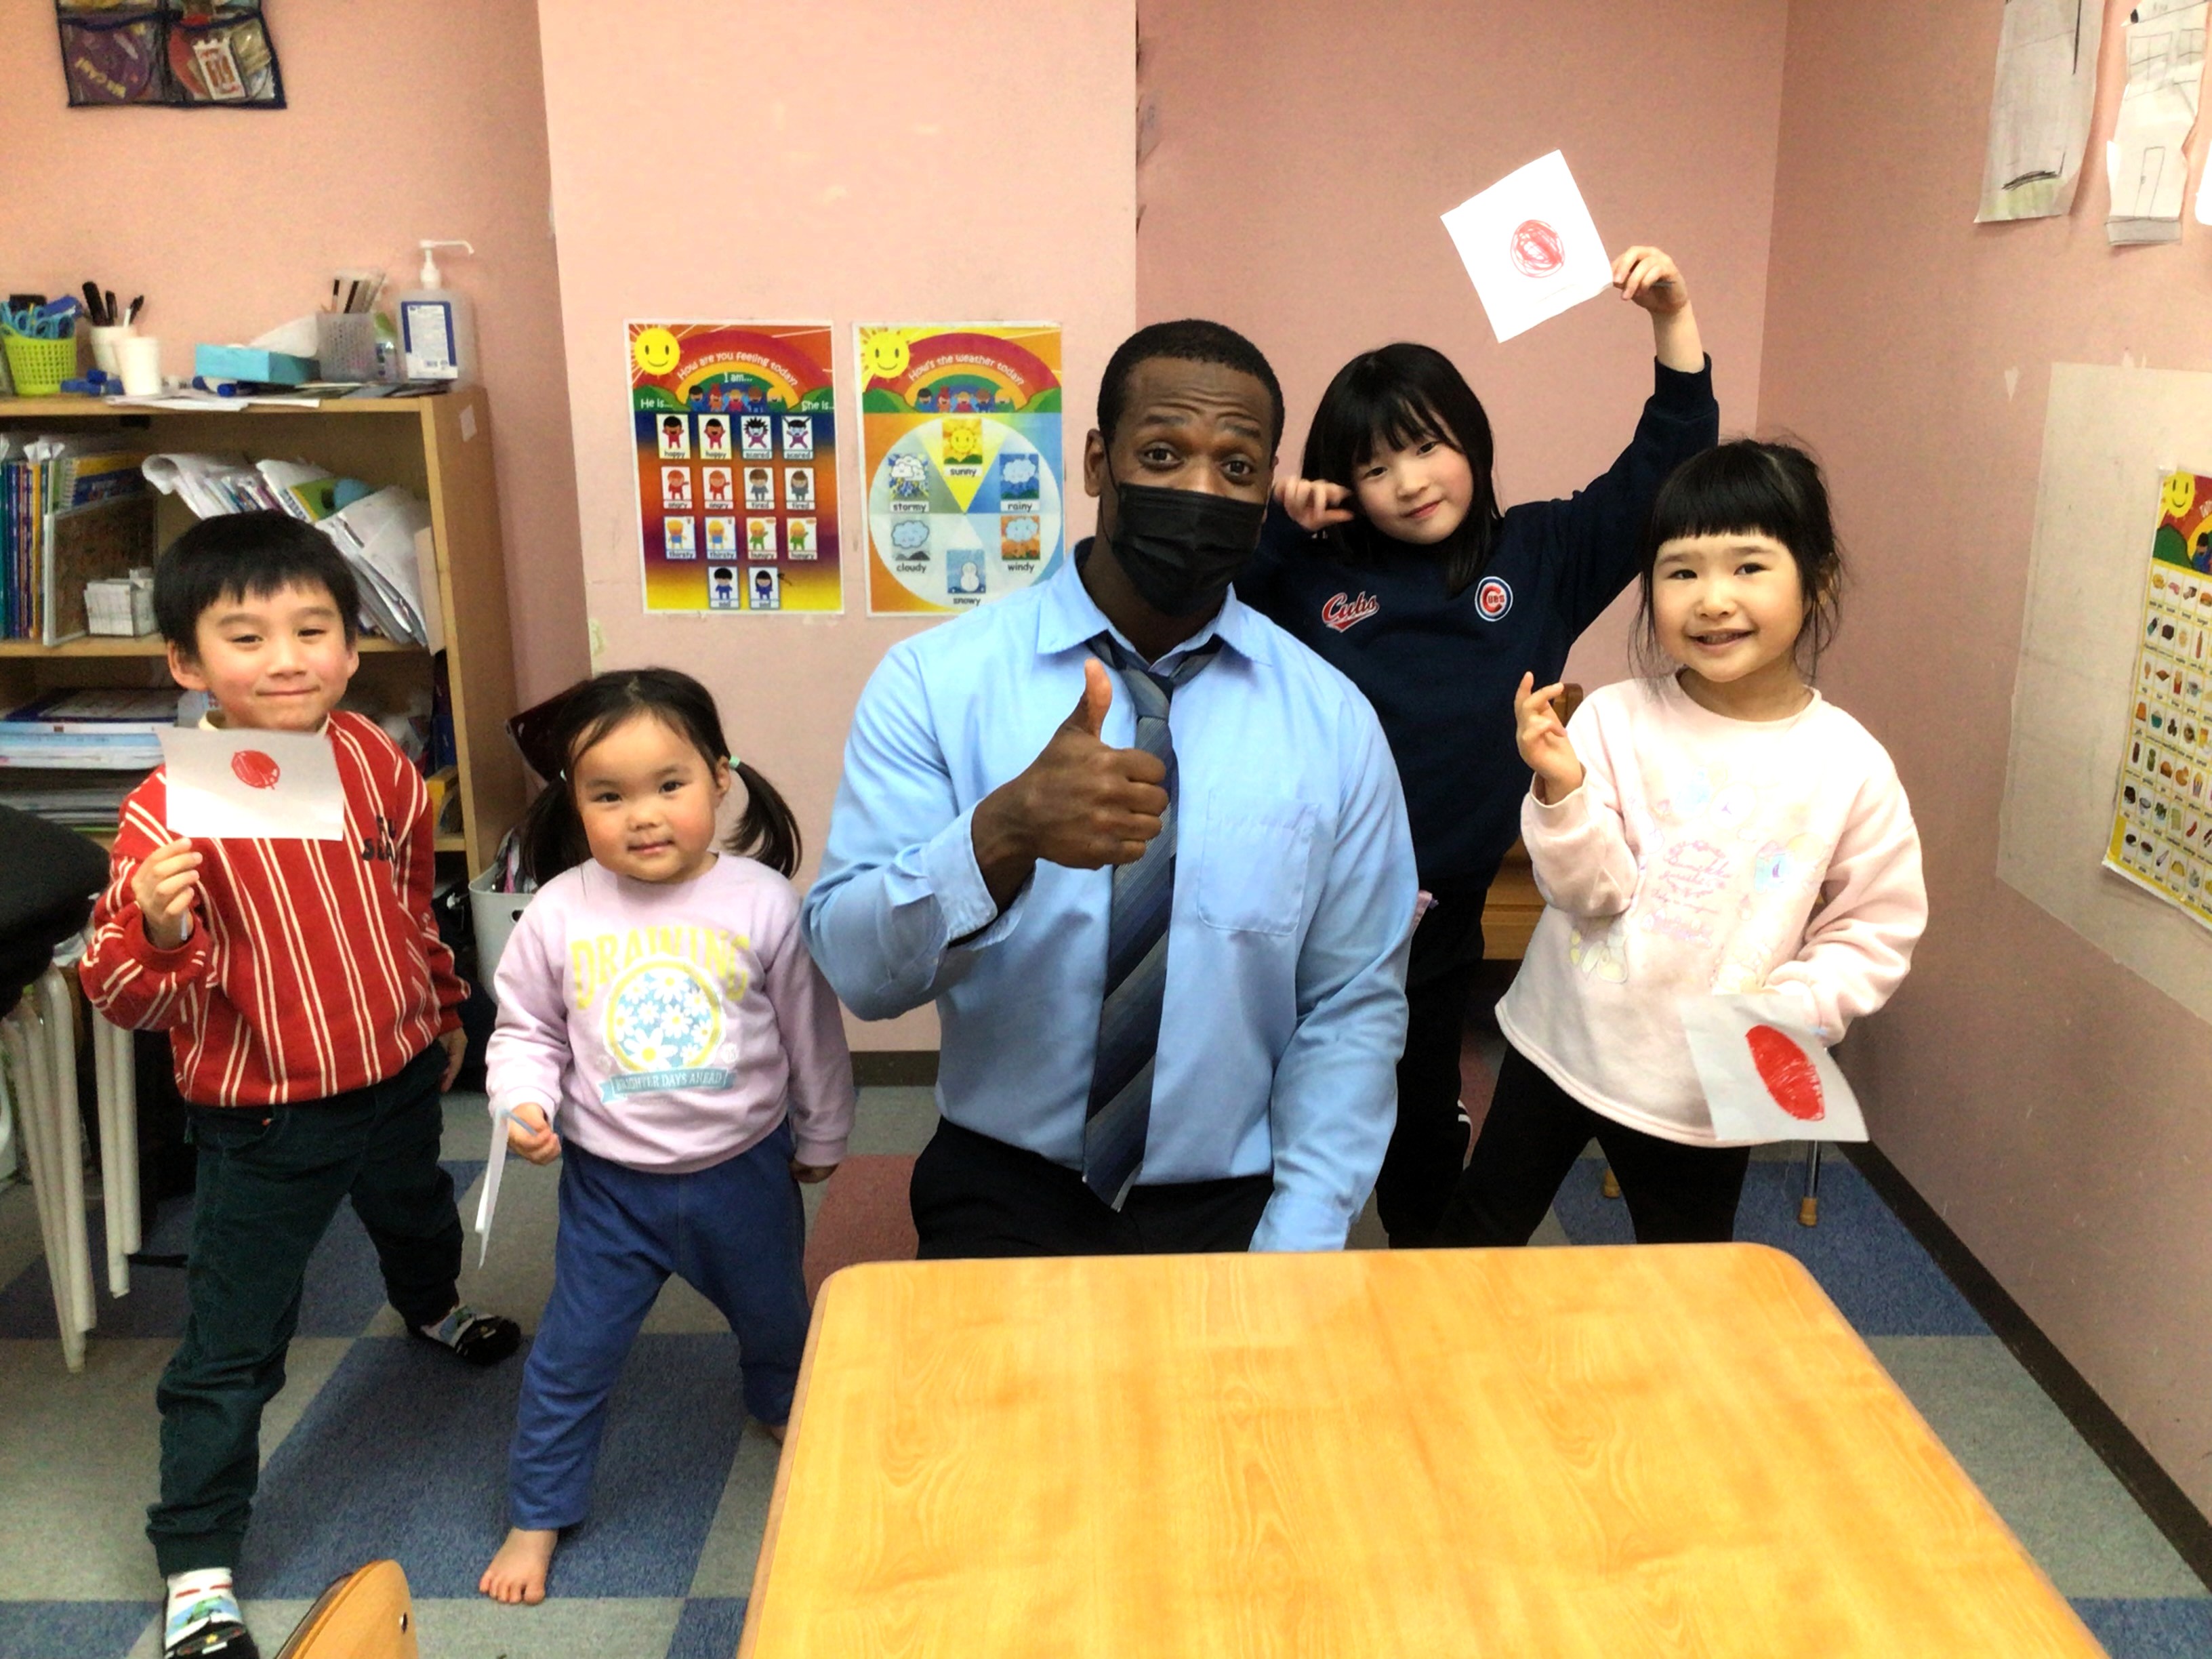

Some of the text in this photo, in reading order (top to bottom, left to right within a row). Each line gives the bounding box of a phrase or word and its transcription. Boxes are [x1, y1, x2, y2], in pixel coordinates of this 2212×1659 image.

[677, 351, 798, 386] How are you feeling today?
[908, 354, 1025, 386] How's the weather today?
[724, 372, 729, 383] I
[640, 398, 655, 409] He
[801, 401, 819, 411] She
[664, 451, 685, 459] happy
[705, 451, 726, 459] happy
[950, 468, 977, 477] sunny
[893, 503, 926, 513] stormy
[1008, 502, 1032, 512] rainy
[896, 563, 926, 573] cloudy
[1008, 563, 1035, 573] windy
[953, 597, 981, 607] snowy
[1322, 590, 1380, 630] Cubs
[571, 926, 750, 1010] DRAWING
[661, 1073, 688, 1086] DAYS
[689, 1071, 722, 1084] AHEAD
